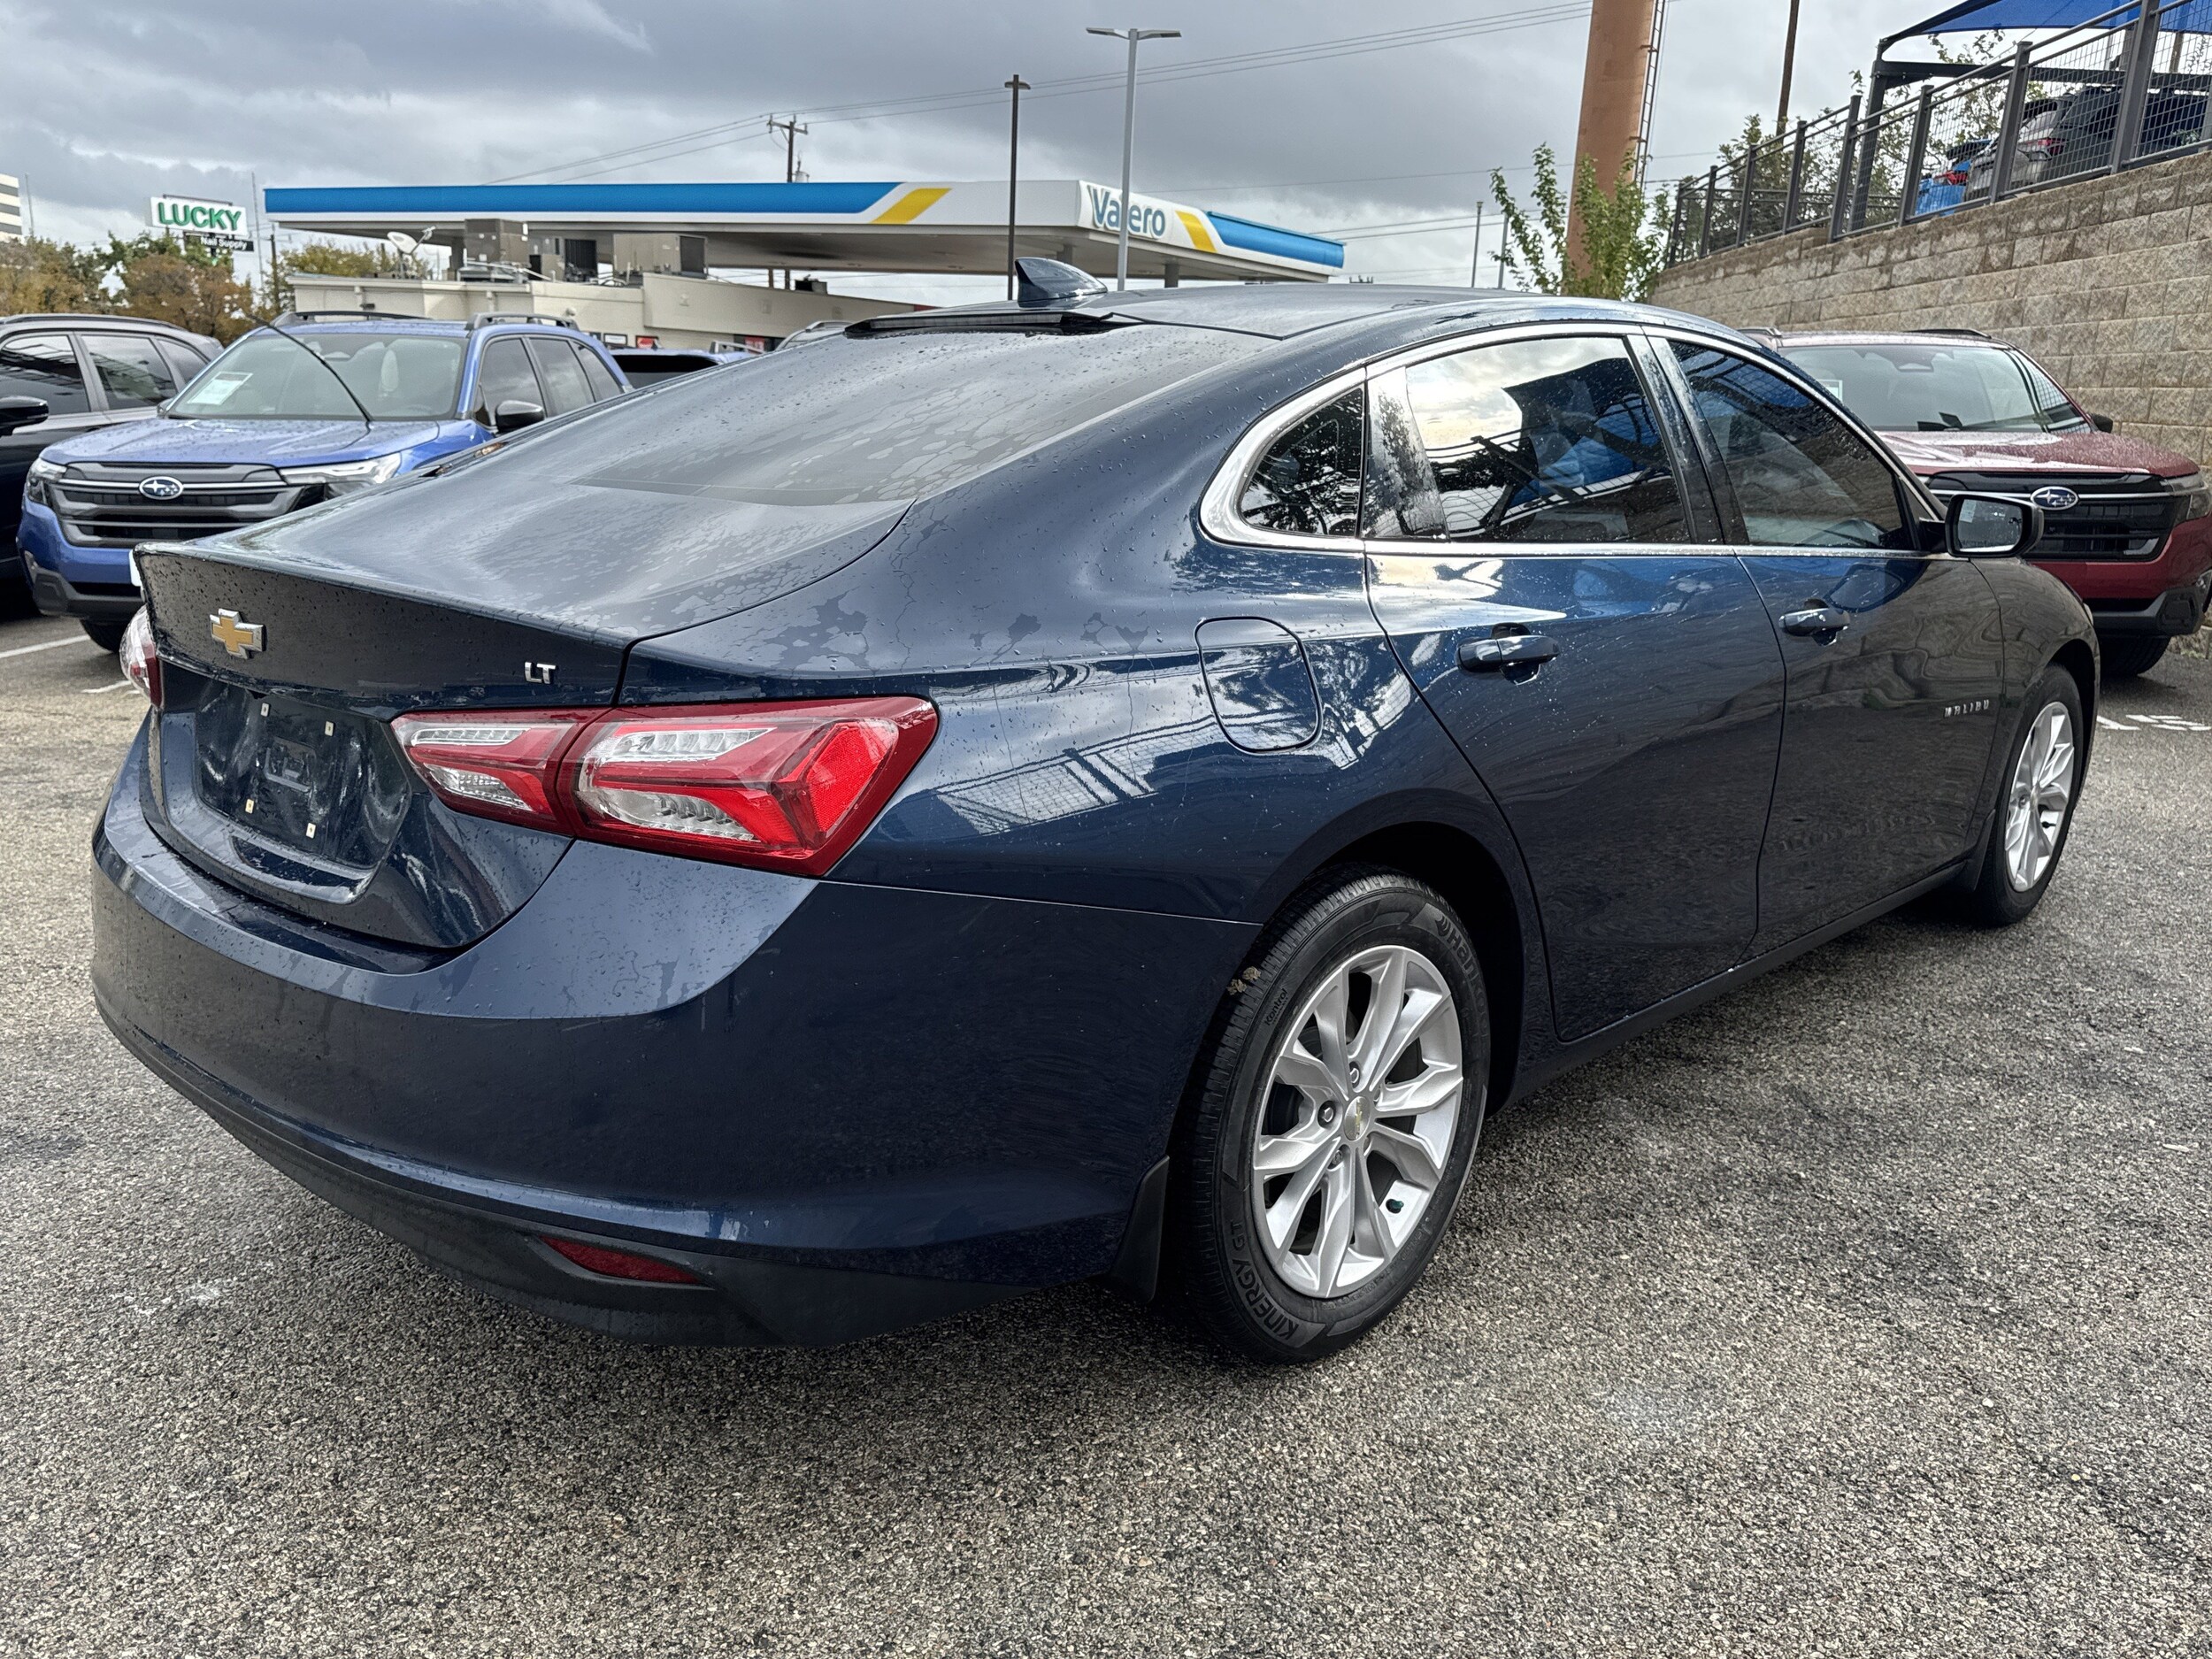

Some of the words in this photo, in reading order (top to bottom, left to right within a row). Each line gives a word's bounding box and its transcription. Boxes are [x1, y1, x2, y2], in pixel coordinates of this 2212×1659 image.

[157, 202, 242, 231] LUCKY
[1090, 187, 1166, 237] Vaero
[218, 238, 247, 251] Supply
[524, 661, 557, 684] LT
[1944, 698, 1990, 718] MALIBU
[1264, 987, 1288, 1026] Kontrol
[1231, 1220, 1246, 1252] GT
[1231, 1258, 1300, 1340] KINERGY
